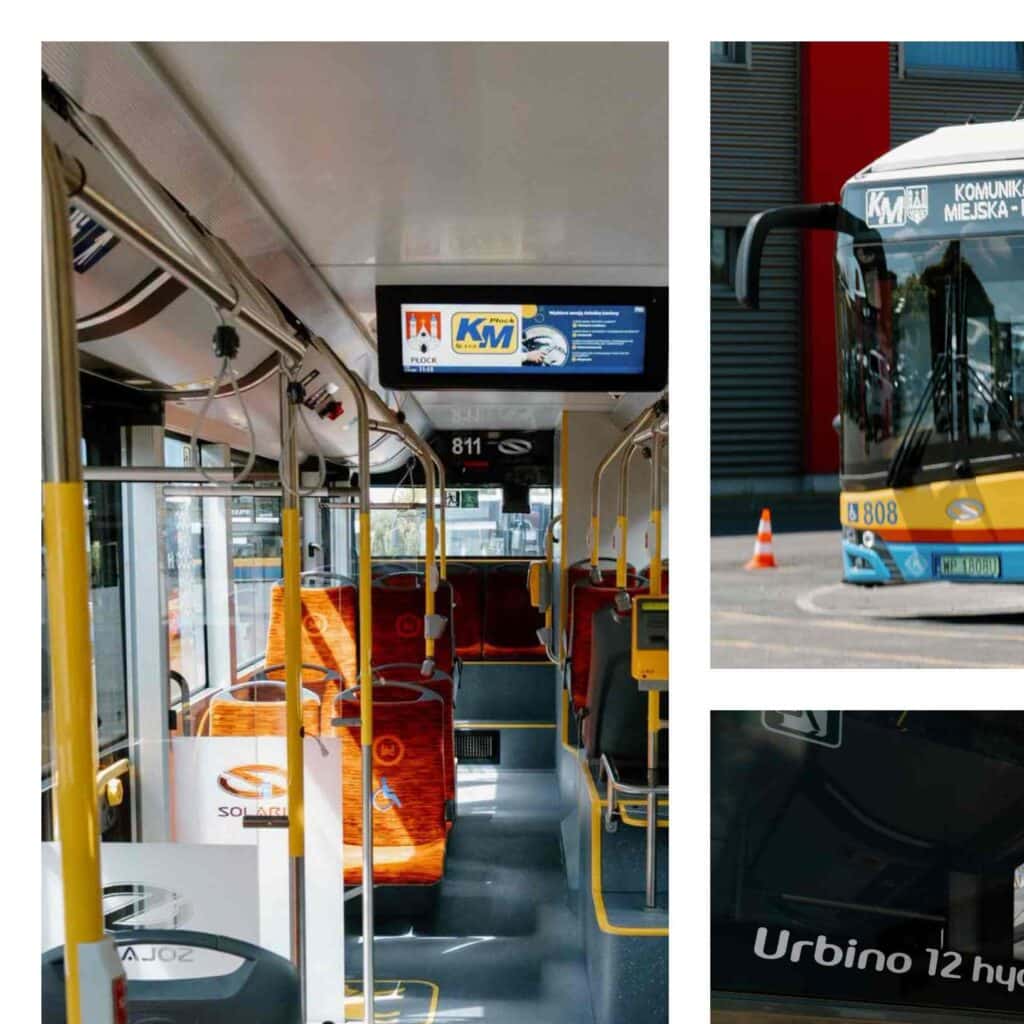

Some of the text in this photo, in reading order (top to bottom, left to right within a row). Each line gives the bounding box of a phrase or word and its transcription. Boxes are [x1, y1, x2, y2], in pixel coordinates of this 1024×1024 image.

[868, 191, 904, 225] KM
[944, 200, 1009, 222] MIEJSKA
[456, 317, 515, 349] KM
[452, 436, 481, 455] 811
[863, 500, 898, 525] 808
[754, 927, 912, 974] Urbino
[926, 948, 962, 980] 12
